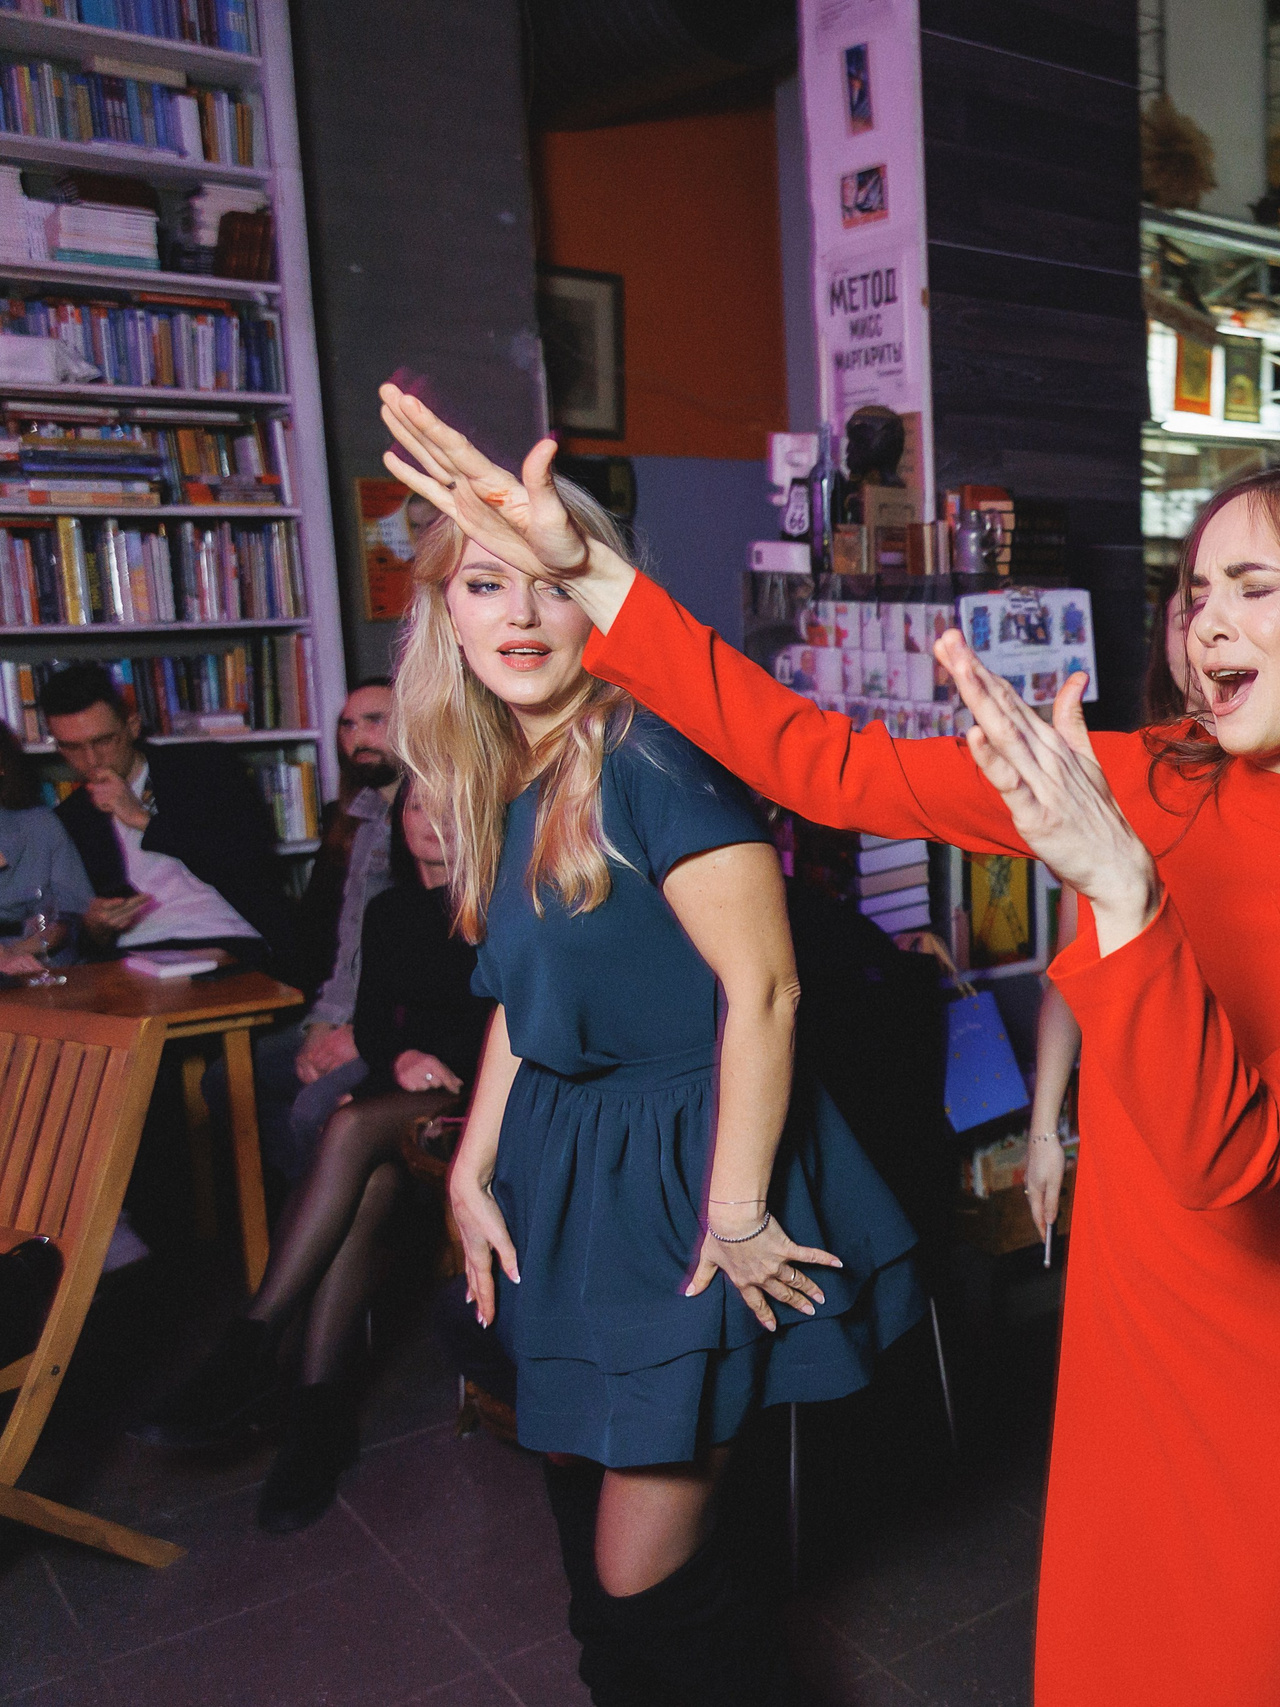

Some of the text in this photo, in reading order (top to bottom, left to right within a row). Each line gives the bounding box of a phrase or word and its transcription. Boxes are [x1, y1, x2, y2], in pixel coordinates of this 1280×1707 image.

[830, 267, 898, 316] МЕТОД
[849, 313, 883, 340] МИСС
[834, 342, 903, 371] МАРГАРИТЫ
